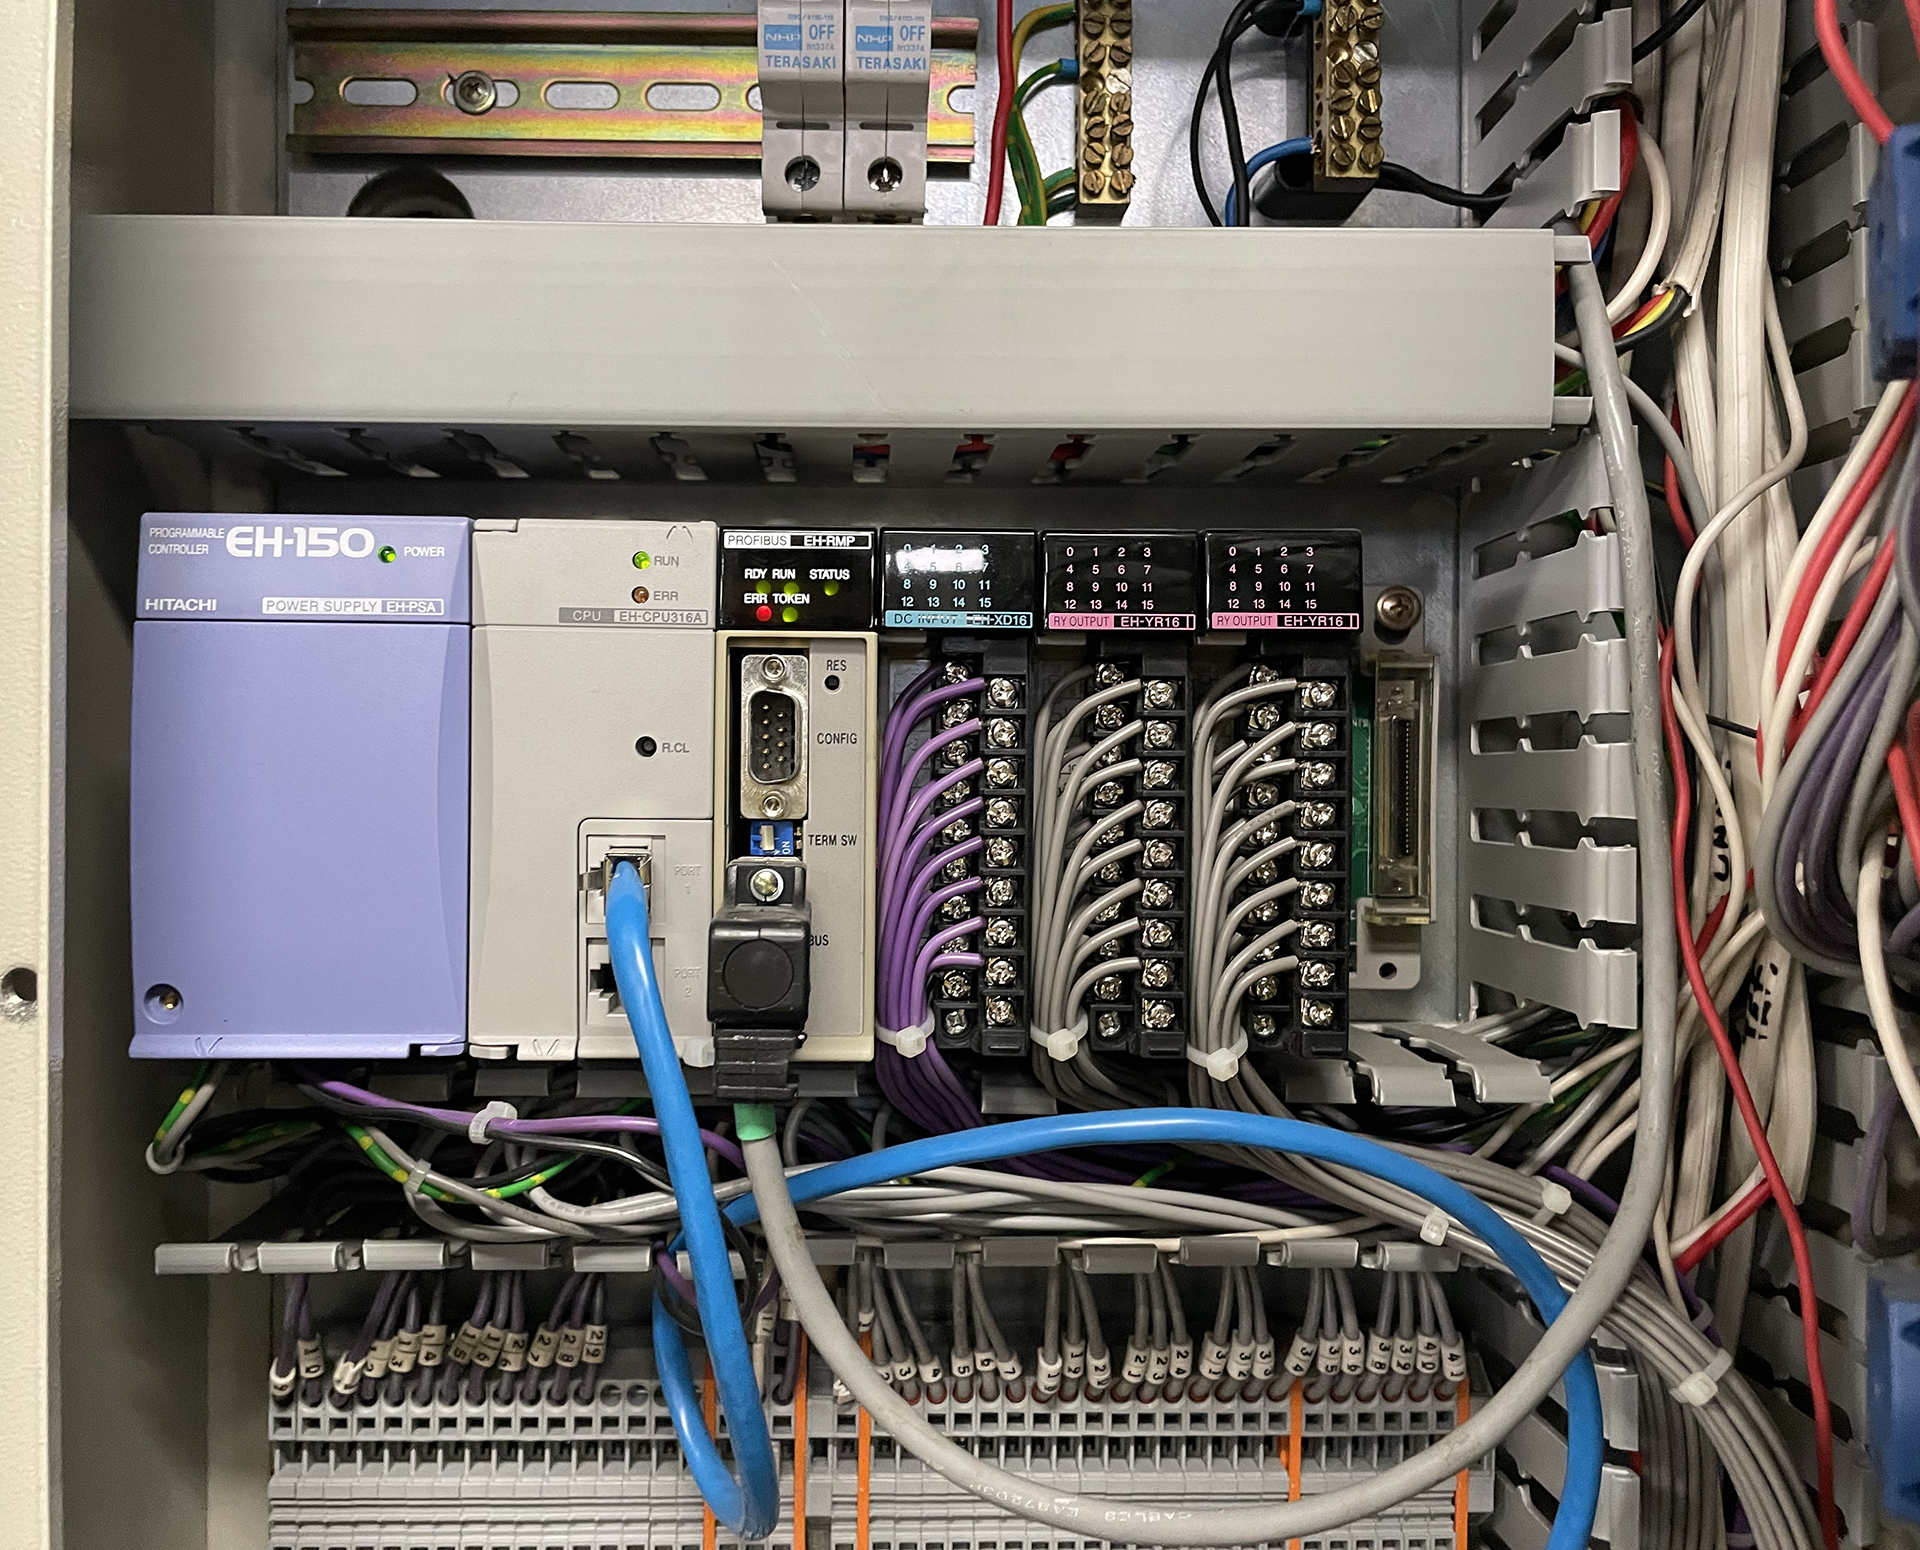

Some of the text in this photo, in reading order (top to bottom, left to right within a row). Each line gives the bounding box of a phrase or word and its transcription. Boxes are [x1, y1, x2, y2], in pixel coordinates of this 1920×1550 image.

[765, 33, 800, 42] NHP
[809, 24, 835, 40] OFF
[900, 25, 926, 41] OFF
[857, 34, 892, 44] NHP
[765, 55, 836, 69] TERASAKI
[856, 56, 927, 70] TERASAKI
[149, 527, 225, 539] PROGRAMMABLE
[226, 526, 375, 558] EH-150
[728, 535, 856, 547] PROFIBUS EH-RMP
[148, 544, 209, 555] CONTROLLER
[403, 546, 445, 557] POWER
[981, 544, 989, 555] 3
[1066, 547, 1151, 557] 0 1 2 3
[1228, 546, 1314, 557] 0 1 2 3
[653, 556, 680, 566] RUN
[930, 562, 937, 572] 5
[955, 562, 963, 572] 6
[982, 562, 990, 573] 7
[1066, 564, 1152, 575] 4 5 6 7
[1229, 564, 1314, 574] 4 5 6 7
[744, 568, 850, 580] RDY RUN STATUS
[903, 579, 991, 590] 8 9 10 11
[1066, 582, 1152, 592] 8 9 10 11
[1229, 581, 1315, 592] 8 9 10 11
[653, 591, 678, 601] ERR
[743, 593, 810, 605] ERR TOKEN
[901, 596, 992, 608] 12 13 14 15
[145, 598, 217, 612] HITACHI
[266, 600, 436, 613] POWER SUPPLY EH-PSA
[1064, 600, 1154, 610] 12 13 14 15
[1227, 599, 1317, 610] 12 13 14 15
[572, 610, 702, 623] CPU EH-CPU316A
[894, 614, 1027, 626] DC INPUT EH-XD16
[1053, 616, 1180, 628] RY OUTPUT EH-YR16
[1216, 615, 1344, 627] RY OUTPUT EH-YR16
[826, 659, 847, 671] RES
[817, 732, 858, 745] CONFIG
[662, 742, 690, 753] R.CL
[808, 834, 858, 846] TERM SW
[782, 841, 791, 854] ON
[674, 864, 702, 876] PORT
[684, 883, 691, 895] 1
[674, 966, 702, 978] PORT
[684, 985, 692, 997] 2
[453, 1330, 476, 1360] 15
[557, 1333, 577, 1363] 28
[586, 1330, 604, 1358] 29
[1292, 1347, 1312, 1373] 34
[1325, 1345, 1340, 1373] 35
[1347, 1346, 1361, 1372] 36
[1373, 1342, 1390, 1370] 38
[1396, 1344, 1413, 1371] 39
[1421, 1342, 1437, 1370] 40
[1128, 1355, 1147, 1378] 21
[1153, 1356, 1168, 1381] 23
[1174, 1350, 1189, 1375] 24
[1209, 1350, 1226, 1375] 31
[1448, 1353, 1463, 1378] 41
[900, 1367, 911, 1377] 3
[932, 1368, 941, 1378] 4
[958, 1366, 970, 1374] 5
[1004, 1367, 1016, 1375] 7
